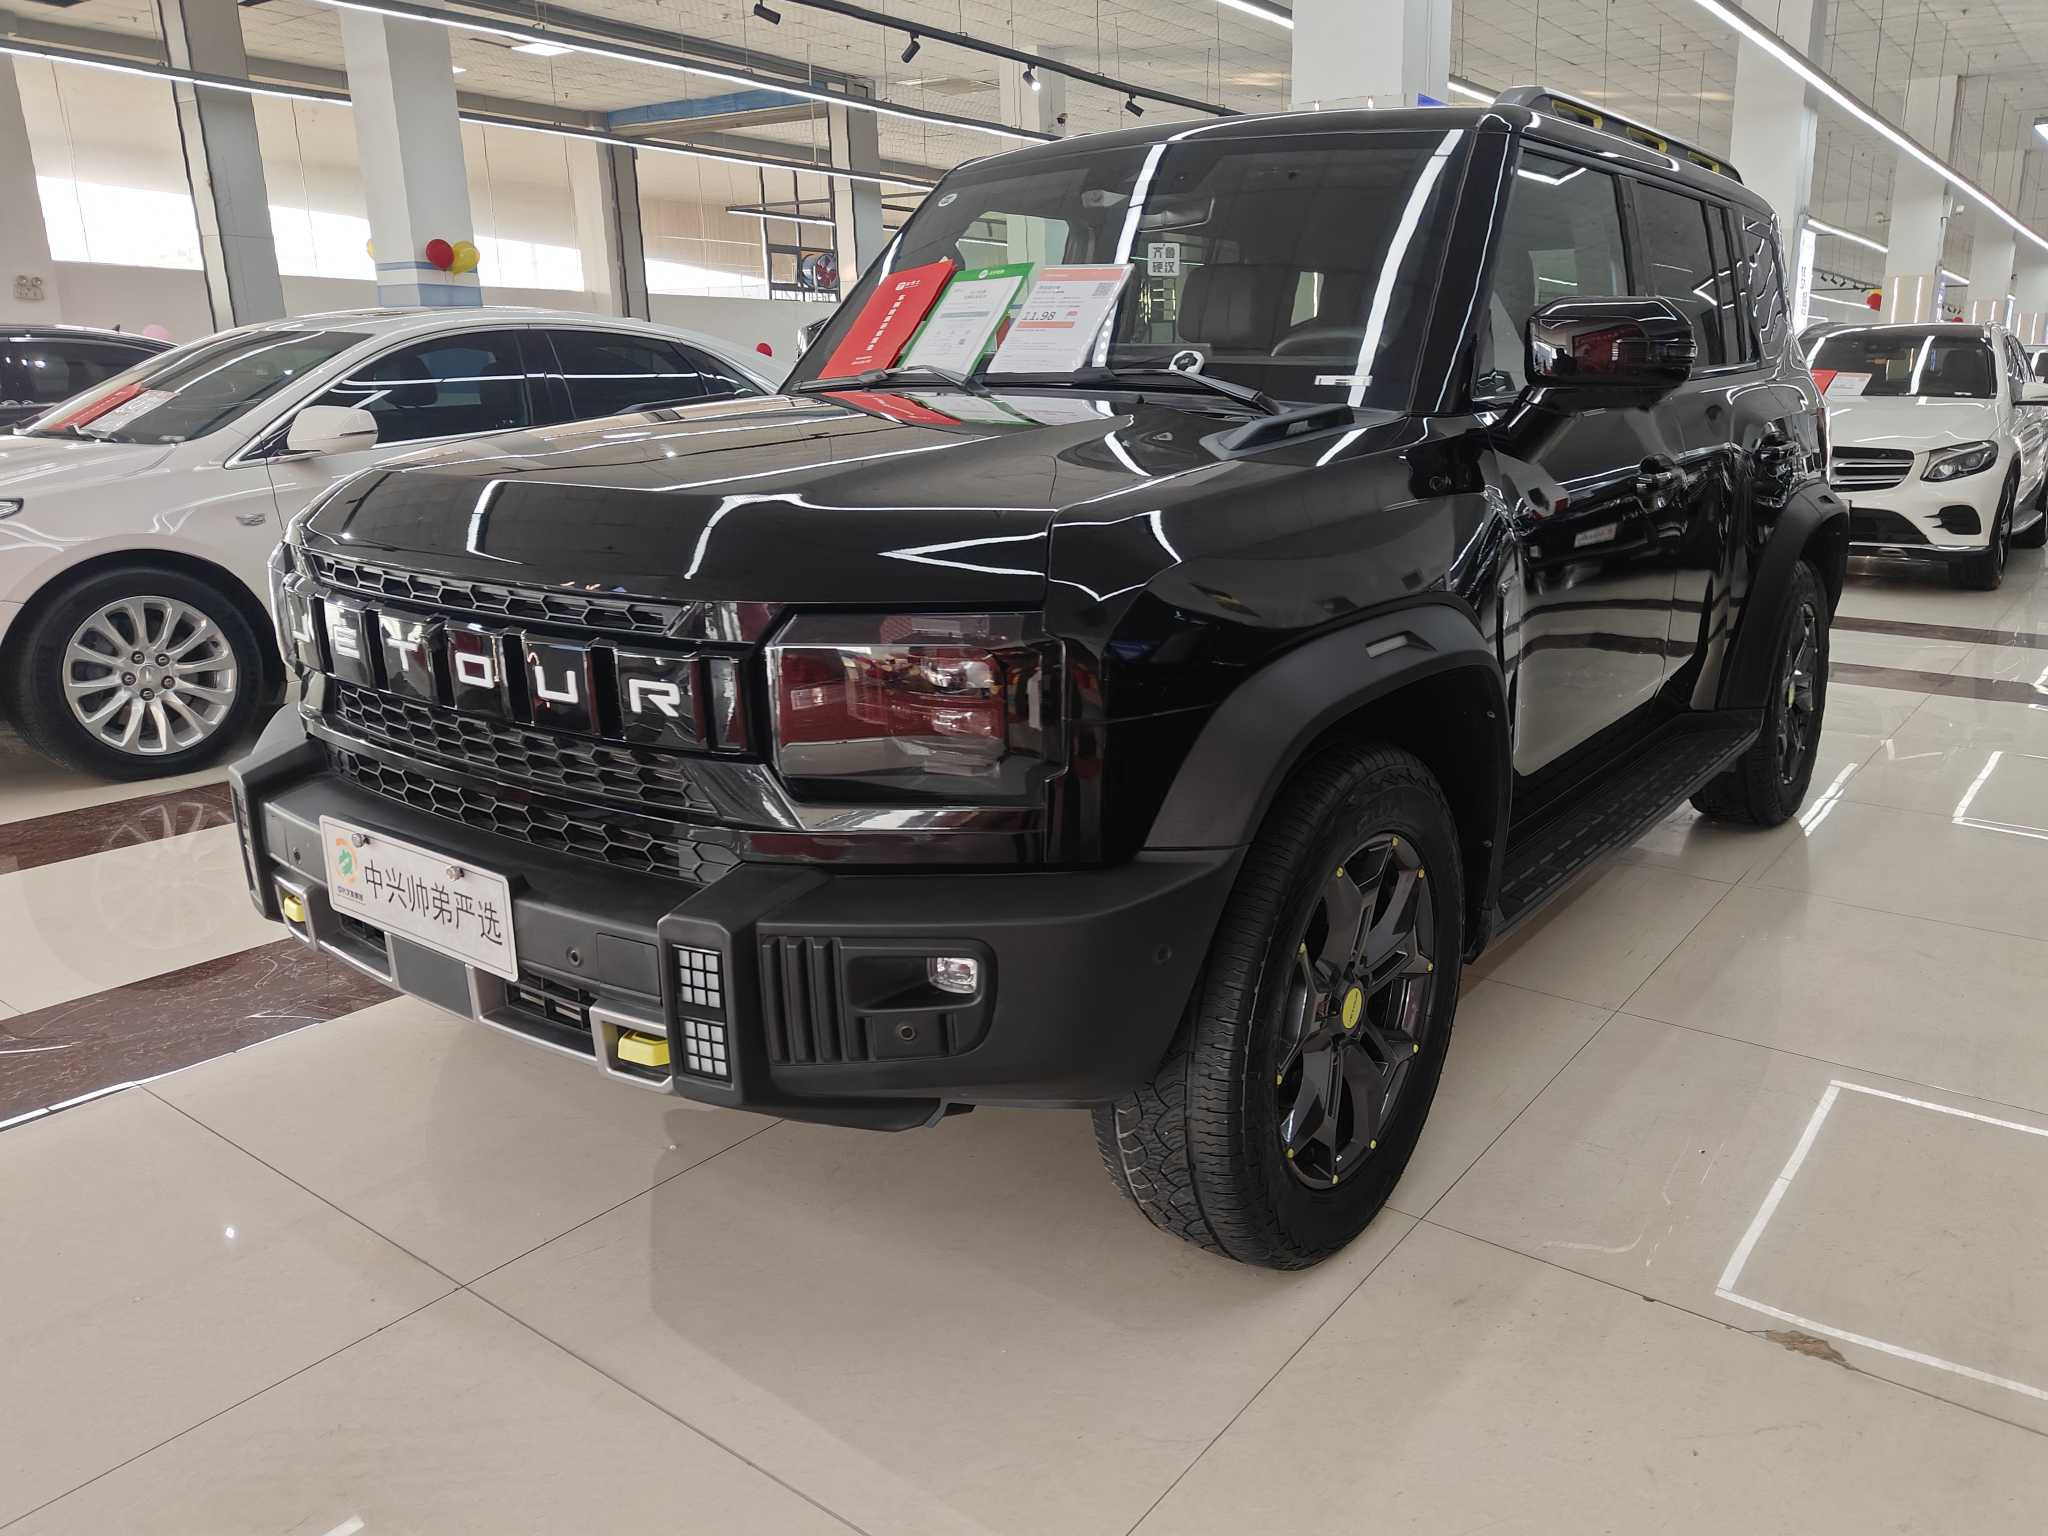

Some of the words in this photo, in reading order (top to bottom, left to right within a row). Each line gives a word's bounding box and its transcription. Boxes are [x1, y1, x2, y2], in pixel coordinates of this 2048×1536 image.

[1021, 311, 1057, 321] 11.98
[291, 612, 681, 718] JETOUR
[364, 859, 503, 946] 中兴帅弟严选
